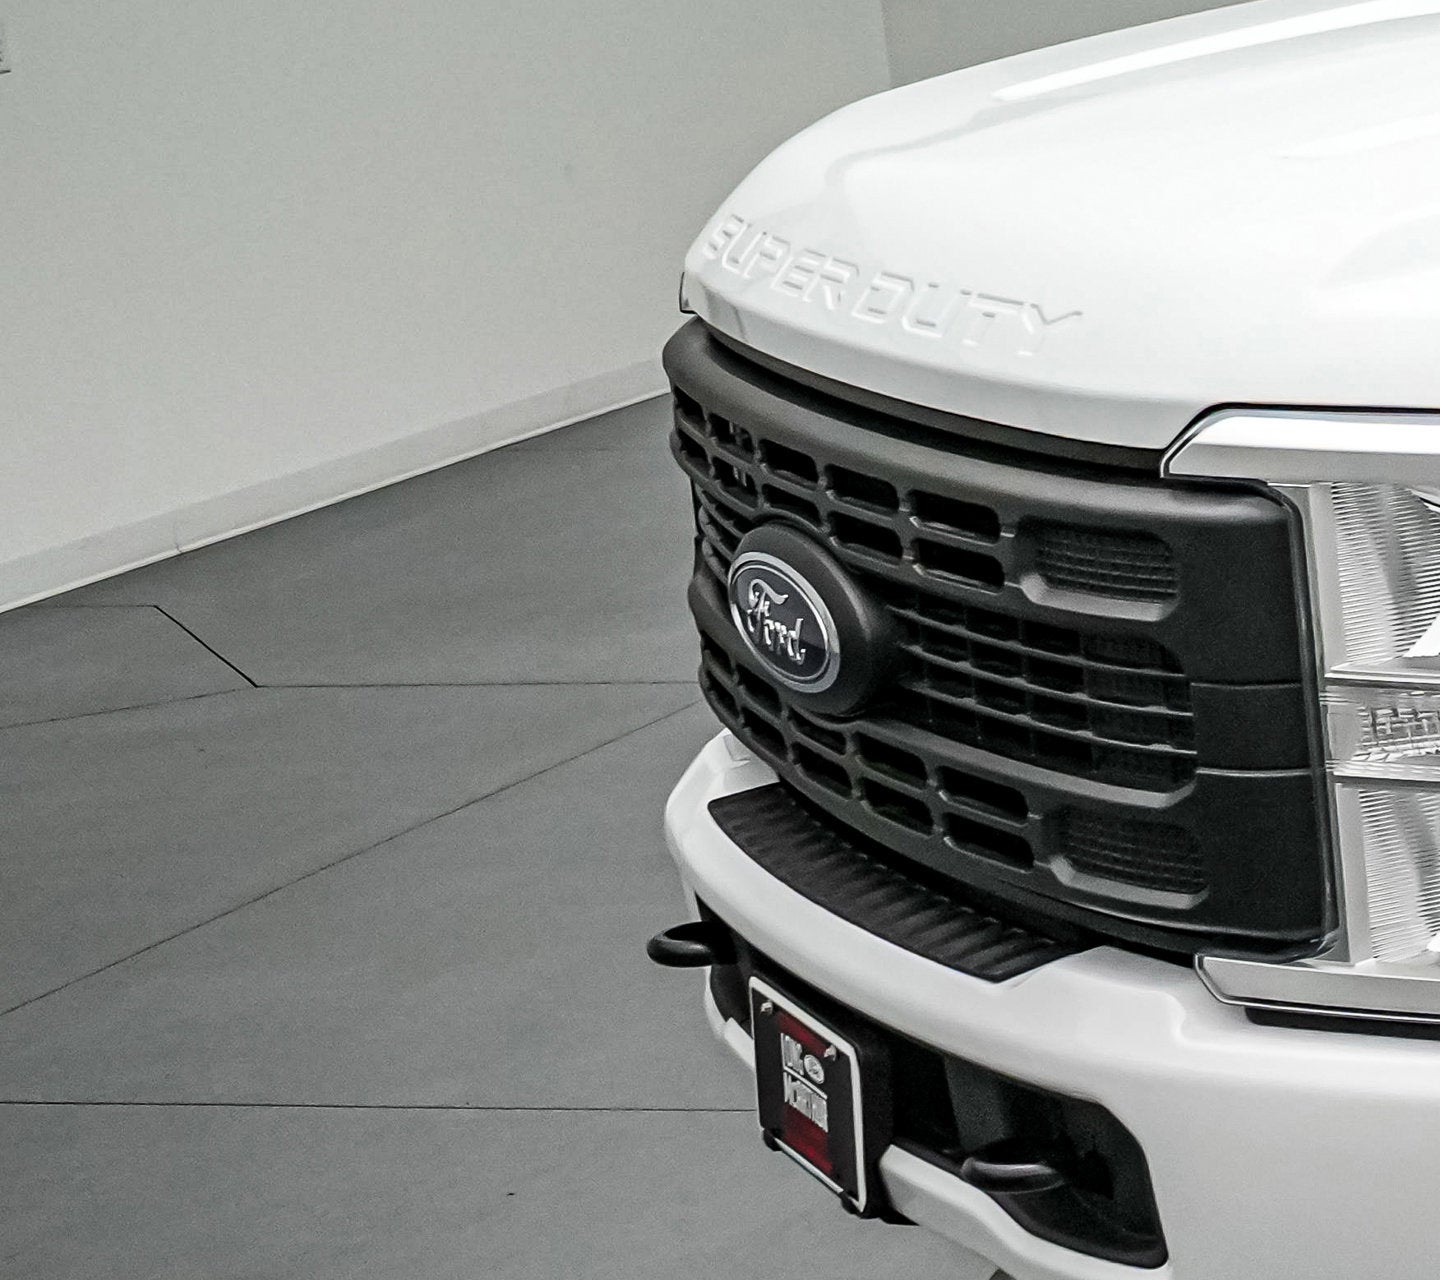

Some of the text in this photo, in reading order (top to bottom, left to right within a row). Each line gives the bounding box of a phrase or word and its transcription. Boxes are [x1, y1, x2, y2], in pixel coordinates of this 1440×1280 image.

[702, 213, 1084, 358] SUPER DUTY
[744, 577, 808, 666] Ford
